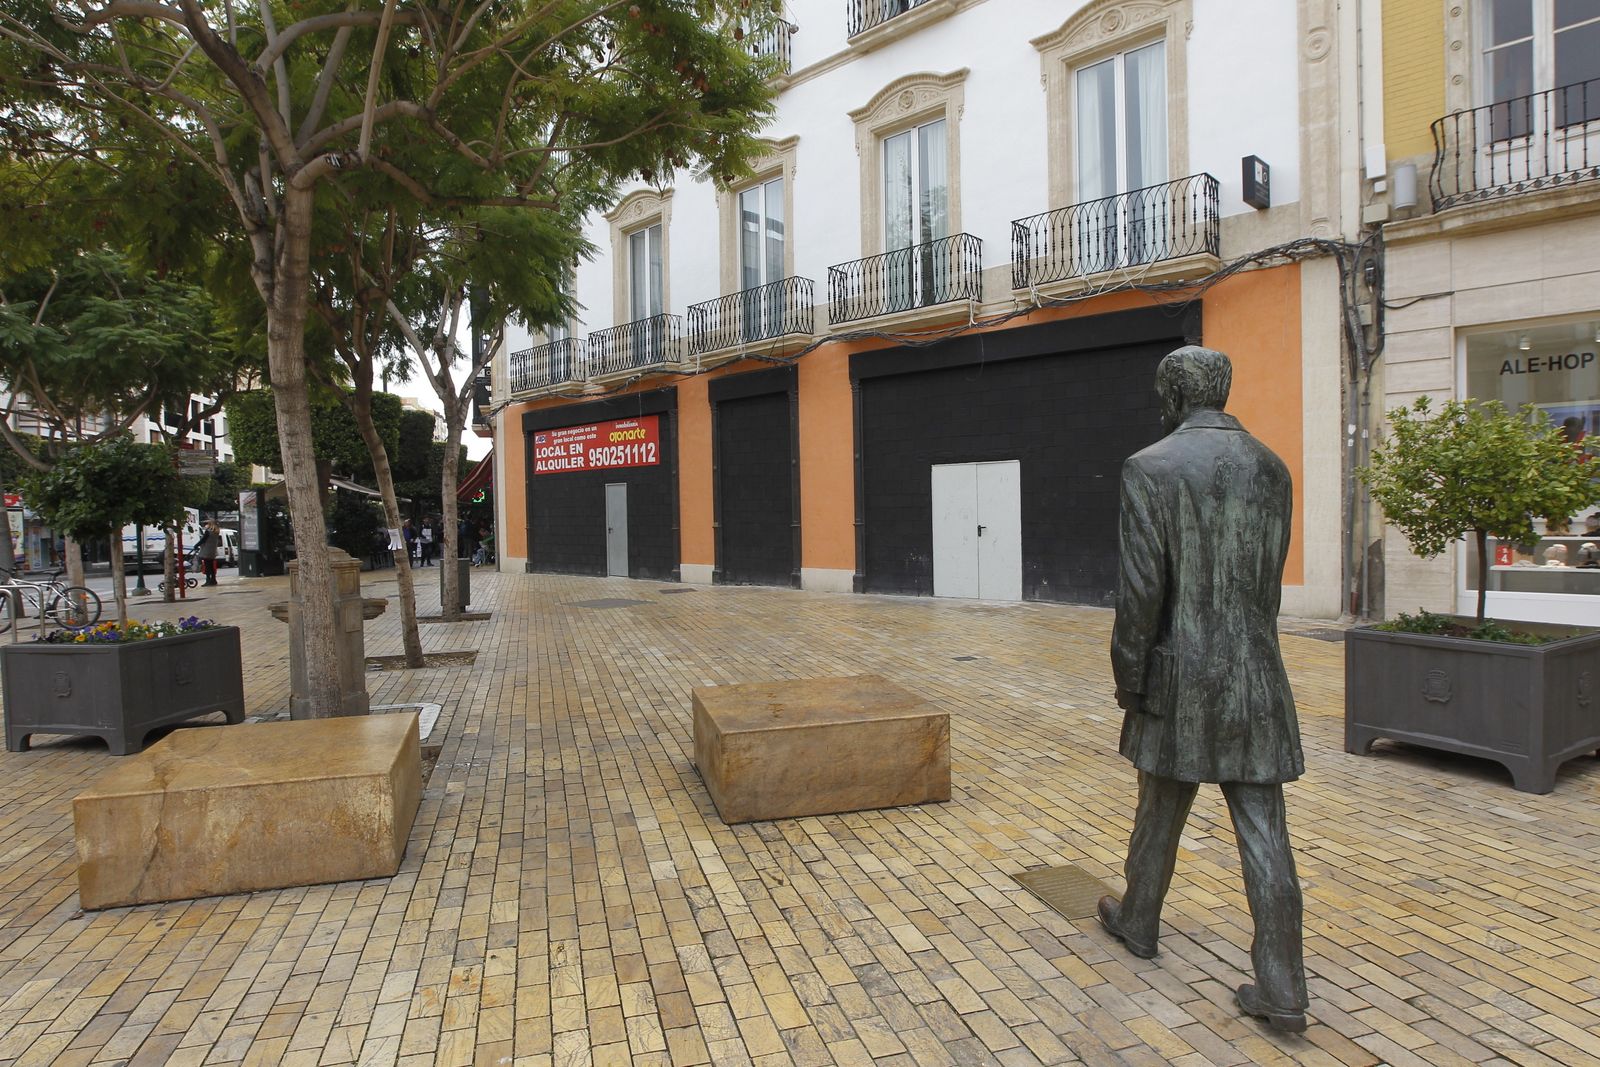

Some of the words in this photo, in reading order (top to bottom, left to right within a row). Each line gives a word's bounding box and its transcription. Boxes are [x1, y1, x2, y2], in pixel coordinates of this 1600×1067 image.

[1499, 352, 1594, 375] ALE-HOP
[568, 427, 584, 435] negocio
[536, 445, 567, 459] LOCAL
[569, 443, 583, 455] EN
[589, 442, 656, 467] 950251112
[536, 456, 584, 471] ALQUILER
